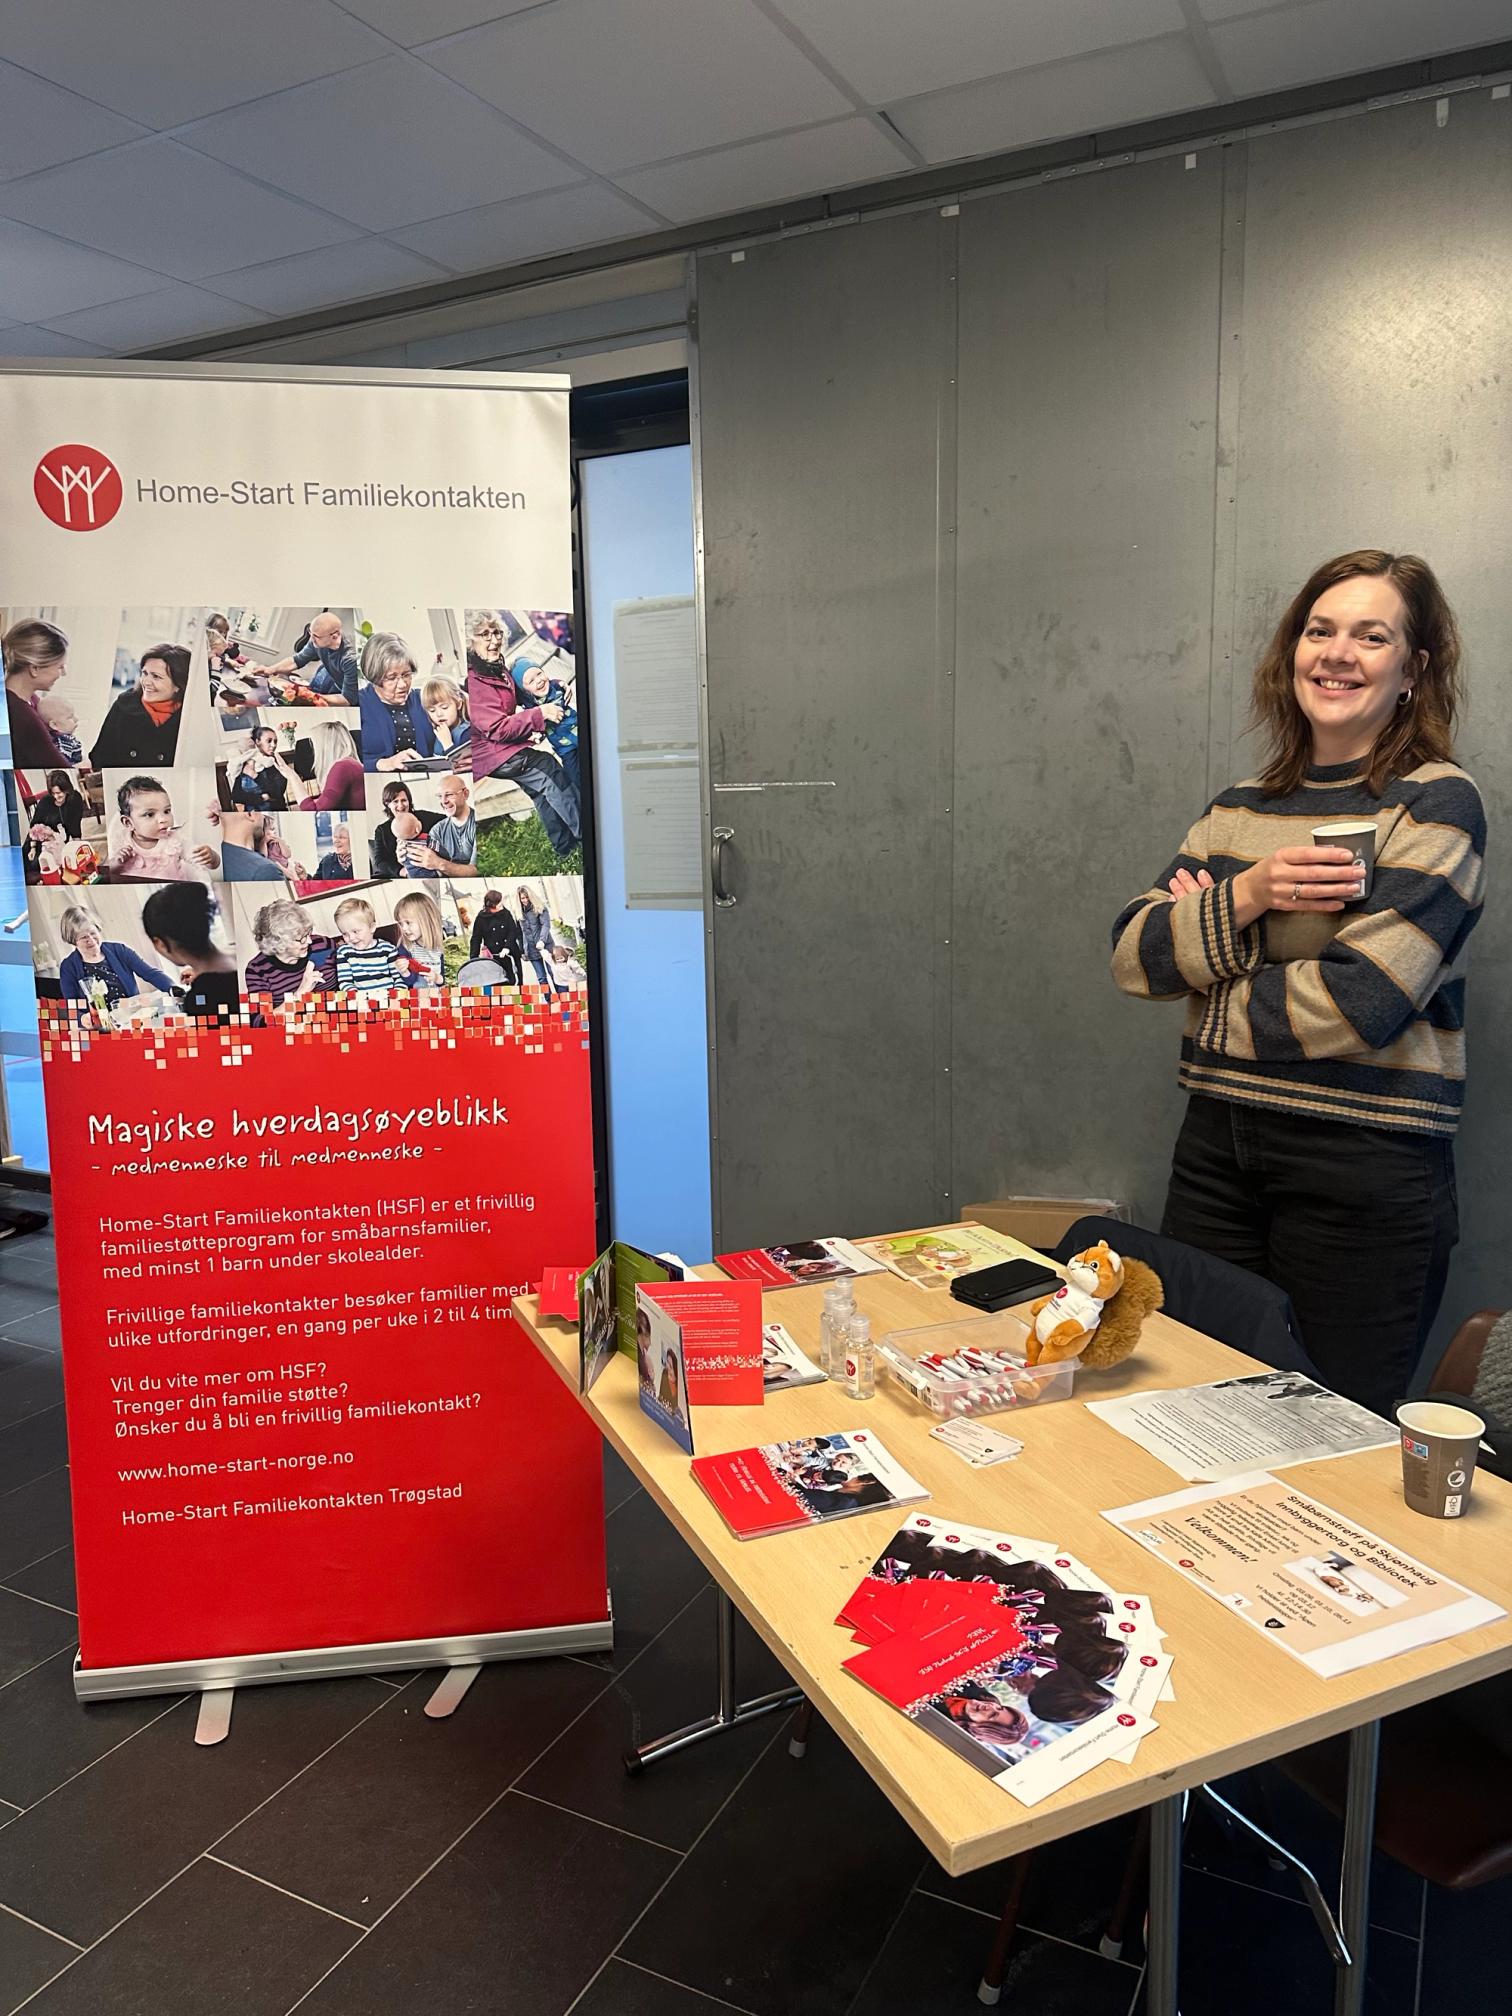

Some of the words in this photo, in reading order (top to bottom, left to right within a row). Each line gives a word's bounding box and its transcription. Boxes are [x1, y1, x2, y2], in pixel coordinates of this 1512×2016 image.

[137, 478, 295, 506] Home-Start
[303, 482, 527, 510] Familiekontakten
[88, 1109, 213, 1152] Magiske
[232, 1094, 508, 1140] hverdagsøyeblikk
[111, 1151, 247, 1175] medmenneske
[257, 1147, 281, 1167] til
[291, 1142, 422, 1165] medmenneske
[99, 1212, 208, 1232] Home-Start
[215, 1203, 370, 1225] Familiekontakten
[377, 1196, 424, 1216] (HSF)
[431, 1200, 448, 1211] er
[454, 1197, 470, 1211] et
[475, 1193, 534, 1211] frivillig
[100, 1233, 294, 1255] familiestøtteprogram
[300, 1228, 325, 1243] for
[331, 1218, 490, 1241] småbarnsfamilier,
[103, 1262, 141, 1278] med
[149, 1259, 200, 1276] minst
[207, 1257, 213, 1271] 1
[222, 1254, 262, 1271] barn
[269, 1251, 322, 1268] under
[327, 1244, 423, 1264] skolealder.
[106, 1306, 184, 1324] Frivillige
[190, 1296, 338, 1318] familiekontakter
[344, 1290, 414, 1307] besøker
[420, 1284, 486, 1301] familier
[492, 1281, 528, 1297] med
[108, 1331, 151, 1347] ulike
[157, 1325, 270, 1343] utfordringer,
[276, 1323, 297, 1335] en
[303, 1320, 346, 1337] gang
[352, 1317, 381, 1333] per
[387, 1311, 417, 1326] uke
[423, 1309, 427, 1323] i
[433, 1308, 442, 1322] 2
[448, 1306, 465, 1321] til
[470, 1305, 479, 1319] 4
[485, 1304, 512, 1320] tim
[110, 1376, 133, 1392] Vil
[139, 1375, 160, 1390] du
[166, 1373, 197, 1388] vite
[204, 1372, 240, 1385] mer
[246, 1370, 273, 1382] om
[280, 1362, 326, 1379] HSF?
[112, 1399, 184, 1415] Trenger
[189, 1393, 215, 1408] din
[221, 1388, 282, 1406] familie
[288, 1382, 347, 1401] støtte?
[115, 1417, 179, 1437] Ønsker
[185, 1416, 206, 1431] du
[212, 1413, 221, 1429] å
[228, 1412, 248, 1427] bli
[255, 1414, 275, 1425] en
[281, 1406, 341, 1424] frivillig
[347, 1392, 480, 1418] familiekontakt?
[117, 1452, 353, 1481] www.home-start-norge.no
[122, 1503, 227, 1525] Home-Start
[233, 1492, 383, 1515] Familiekontakten
[388, 1482, 461, 1504] Trøgstad
[1287, 1496, 1364, 1539] Småbarnstreff
[1358, 1540, 1379, 1550] på
[1184, 1517, 1258, 1563] Velkommen!
[1349, 1547, 1367, 1557] og
[1366, 1557, 1418, 1588] Bibliotek
